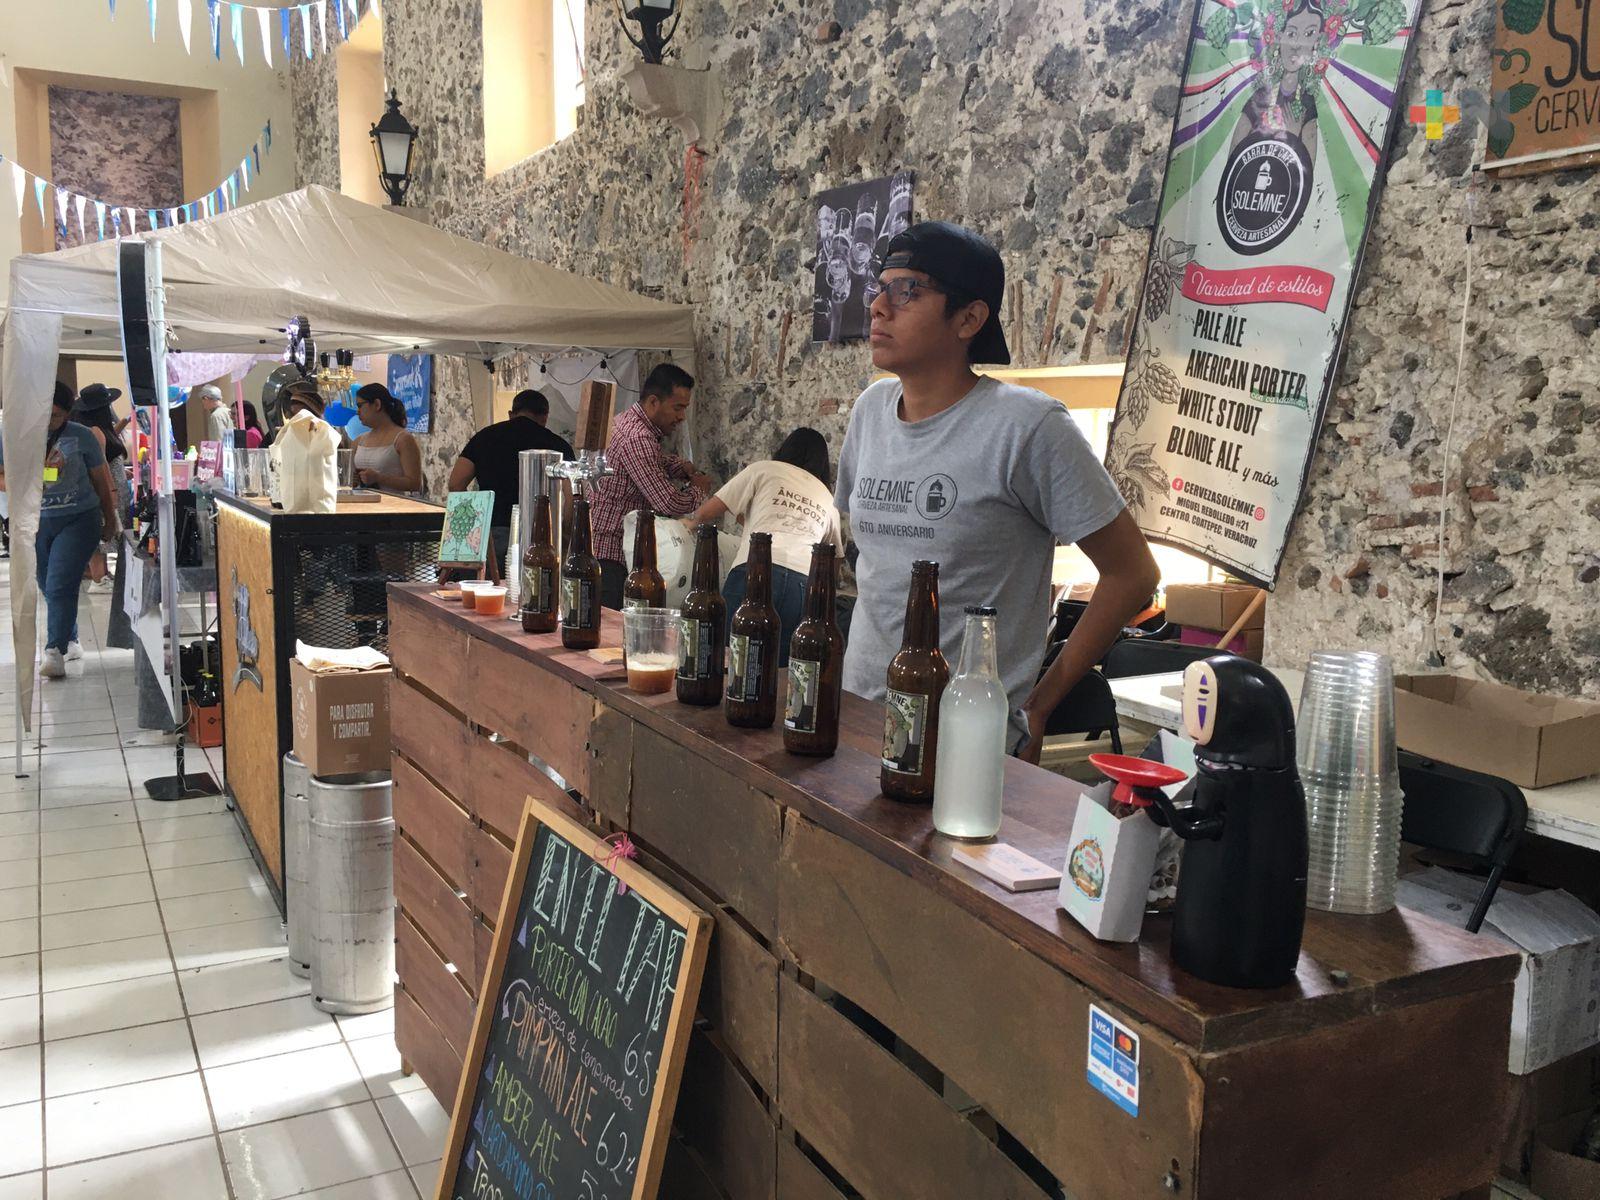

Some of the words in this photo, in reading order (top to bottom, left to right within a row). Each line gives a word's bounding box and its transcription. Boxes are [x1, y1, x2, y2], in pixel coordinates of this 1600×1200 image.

[1534, 86, 1600, 134] CERV
[1241, 145, 1266, 165] BARRA
[1267, 144, 1279, 157] DE
[1232, 190, 1286, 214] SOLEMNE
[1226, 215, 1247, 241] CERVEZA
[1247, 215, 1288, 241] ARTESANAL
[1191, 271, 1257, 297] Variedad
[1257, 274, 1276, 294] de
[1277, 274, 1325, 297] estilos
[1193, 308, 1224, 343] PALE
[1222, 316, 1247, 348] ALE
[1184, 348, 1250, 391] AMERICAN
[1250, 362, 1308, 400] PORTER
[1177, 386, 1217, 425] WHITE
[1215, 398, 1263, 437] STOUT
[1166, 425, 1217, 466] BLONDE
[1215, 440, 1243, 474] ALE
[1242, 466, 1251, 483] y
[1252, 470, 1280, 488] más
[857, 477, 915, 503] SOLEMNE
[1183, 481, 1256, 517] CERVEZASOLEMNE
[859, 520, 874, 534] 6TO
[877, 523, 935, 540] ANIVERSARIO
[1175, 496, 1201, 513] MIGUEL
[1201, 503, 1235, 527] REBOLLEDO
[1235, 519, 1250, 531] #21
[1223, 527, 1258, 549] VERACRUZ
[329, 704, 345, 721] PARA
[345, 702, 375, 720] DISFRUTAR
[332, 723, 337, 740] Y
[533, 832, 580, 936] EN
[531, 923, 576, 1001] PORTER
[568, 967, 592, 1027] CON
[585, 989, 619, 1049] CACAO
[1095, 1018, 1111, 1039] VISA
[531, 985, 566, 1038] Cerveza
[566, 1028, 577, 1053] de
[580, 1039, 634, 1112] temporada
[505, 990, 571, 1114] PUMPKIN
[563, 1065, 598, 1147] ALE
[491, 1060, 534, 1147] AMBER
[529, 1117, 561, 1186] ALE
